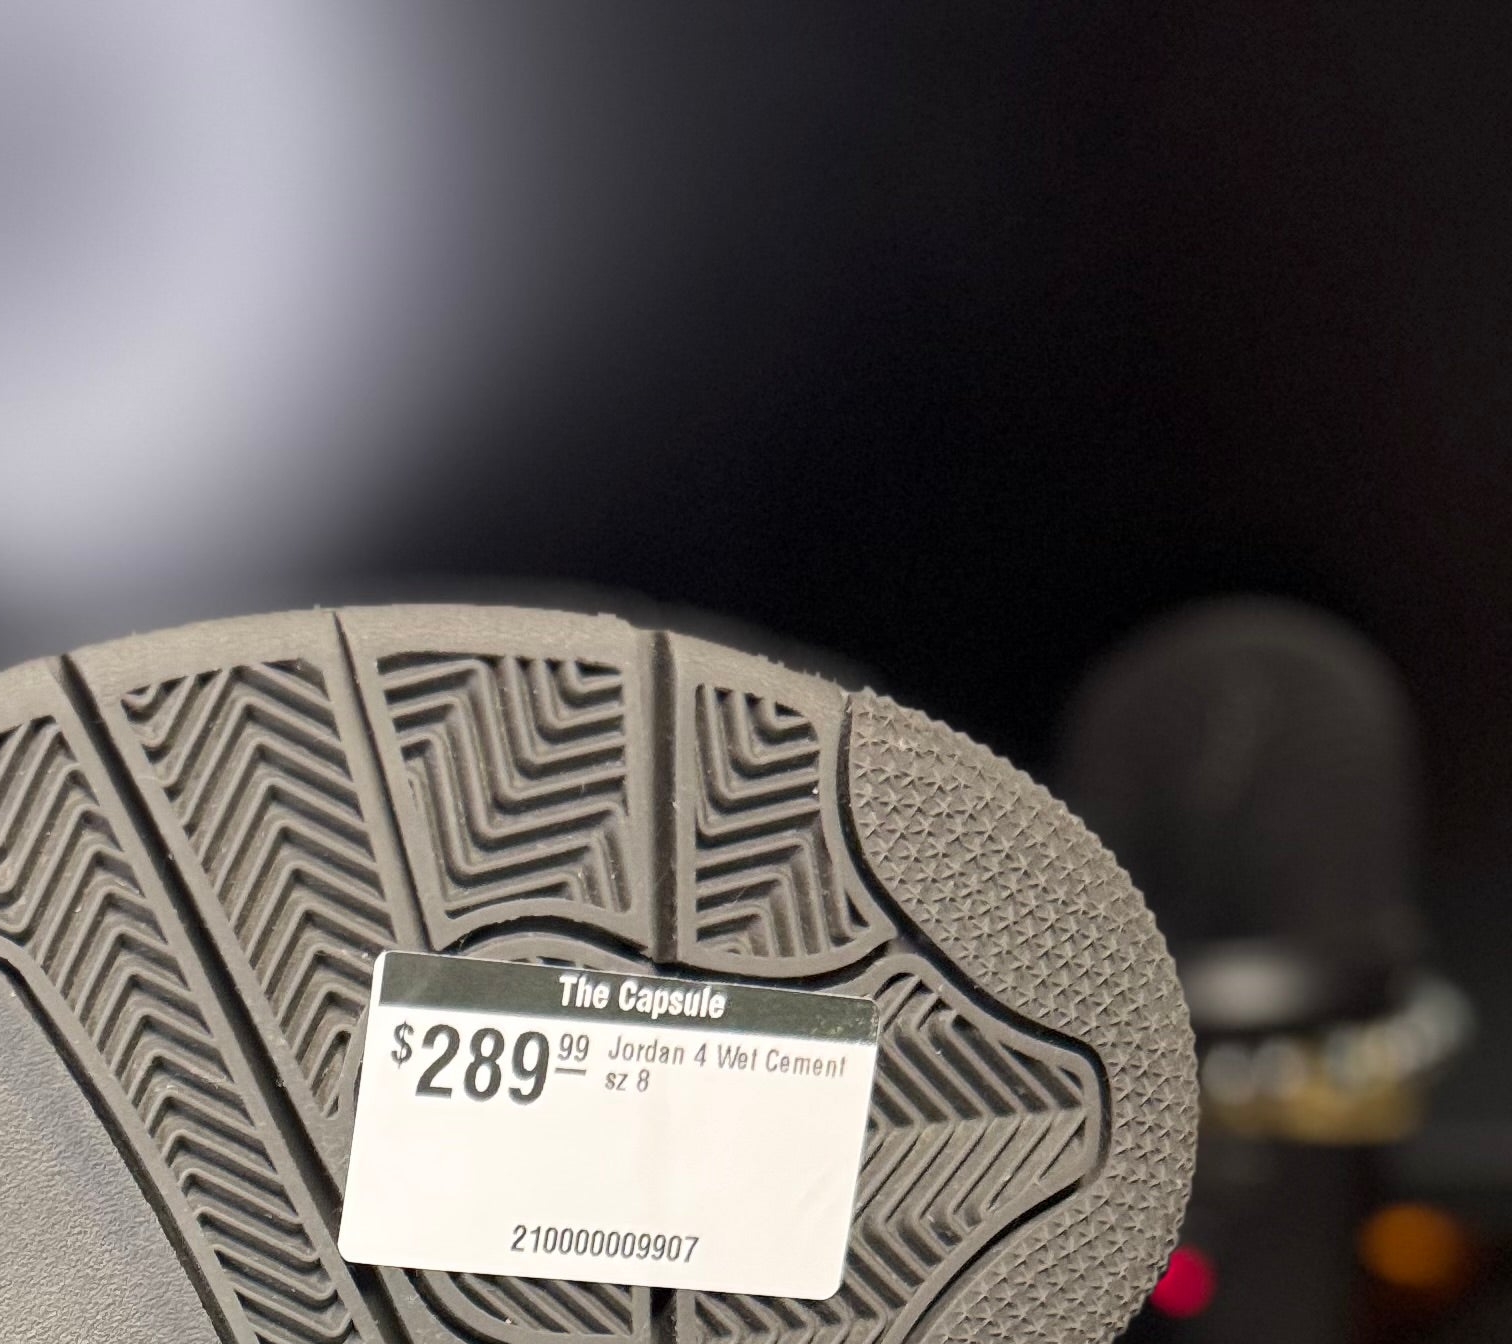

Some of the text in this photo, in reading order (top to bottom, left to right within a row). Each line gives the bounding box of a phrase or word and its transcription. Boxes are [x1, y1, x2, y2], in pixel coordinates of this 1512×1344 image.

[559, 973, 728, 1020] The Capsule
[608, 1034, 847, 1079] Jordan 4 Wet Cement
[605, 1068, 651, 1093] sz 8
[510, 1224, 700, 1264] 210000009907
